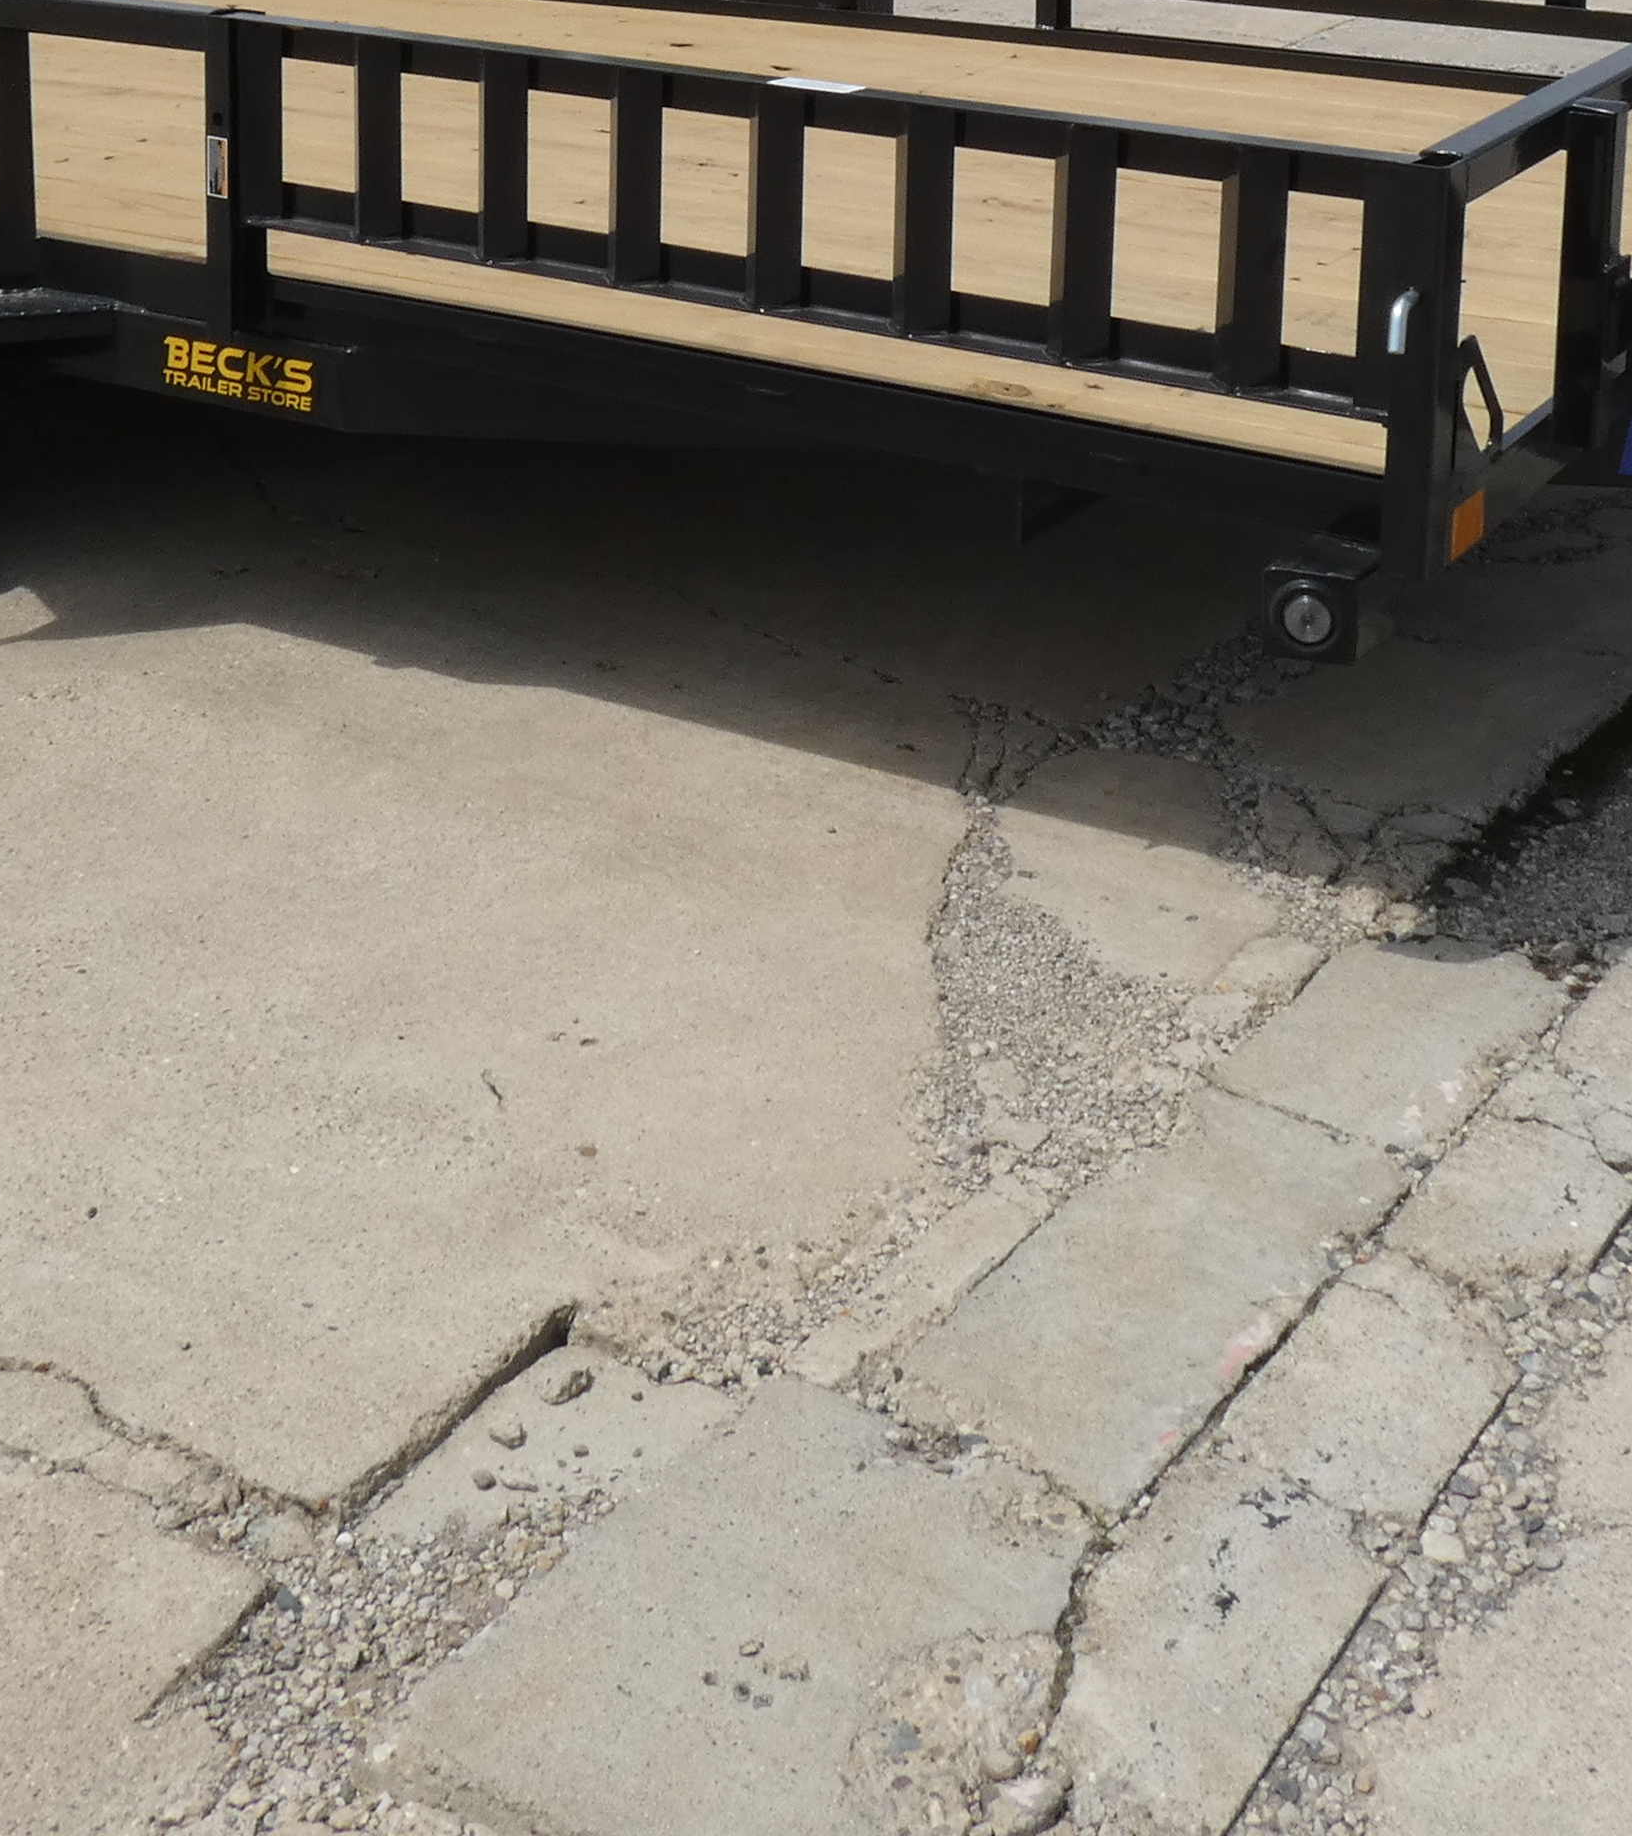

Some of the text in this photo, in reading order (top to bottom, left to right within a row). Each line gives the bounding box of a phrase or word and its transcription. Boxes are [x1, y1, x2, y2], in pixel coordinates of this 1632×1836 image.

[163, 335, 313, 393] BECK'S
[162, 368, 313, 412] TRAILER STORE
